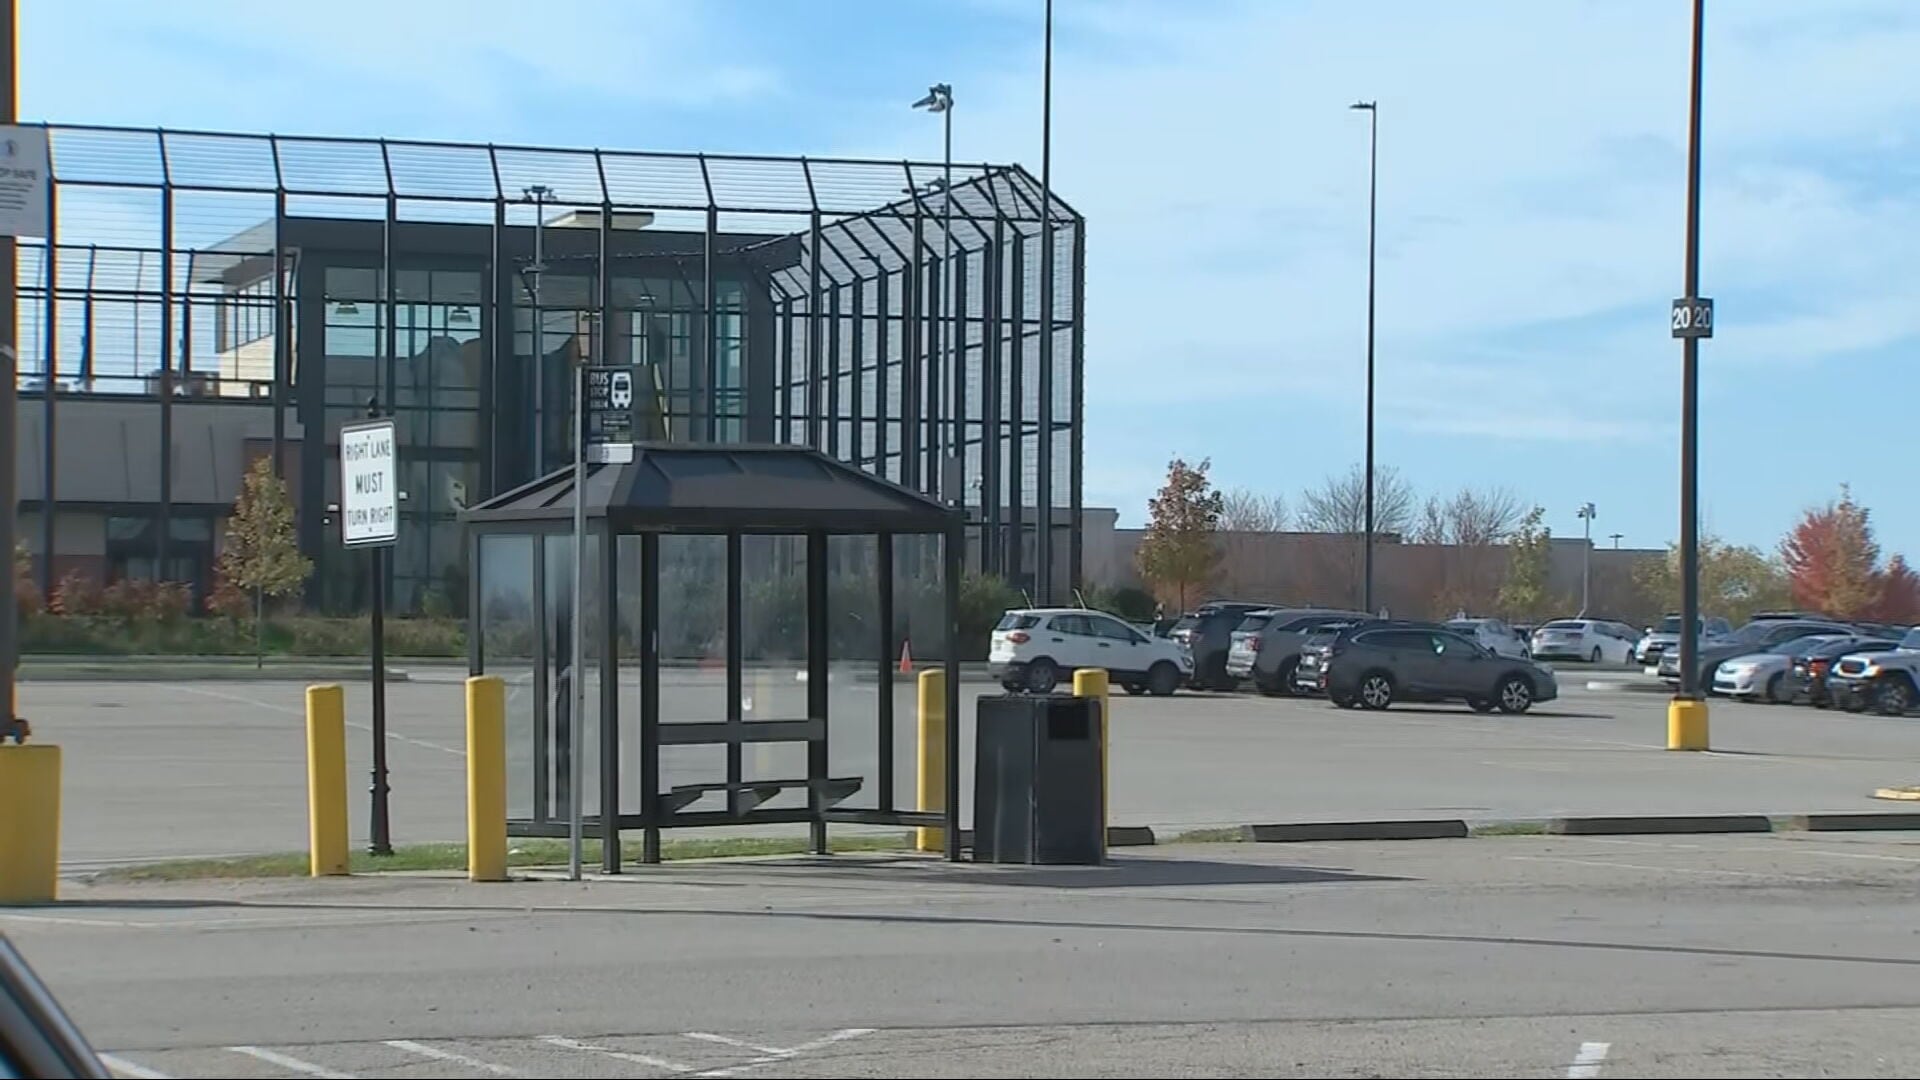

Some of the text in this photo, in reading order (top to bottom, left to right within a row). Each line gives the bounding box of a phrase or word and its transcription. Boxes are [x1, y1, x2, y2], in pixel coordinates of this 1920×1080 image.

[1673, 306, 1691, 329] 20
[1694, 306, 1711, 328] 20
[590, 372, 609, 385] BUS
[346, 438, 392, 461] RIGHT LANE
[355, 471, 383, 494] MUST
[347, 504, 393, 526] TURN RIGHT
